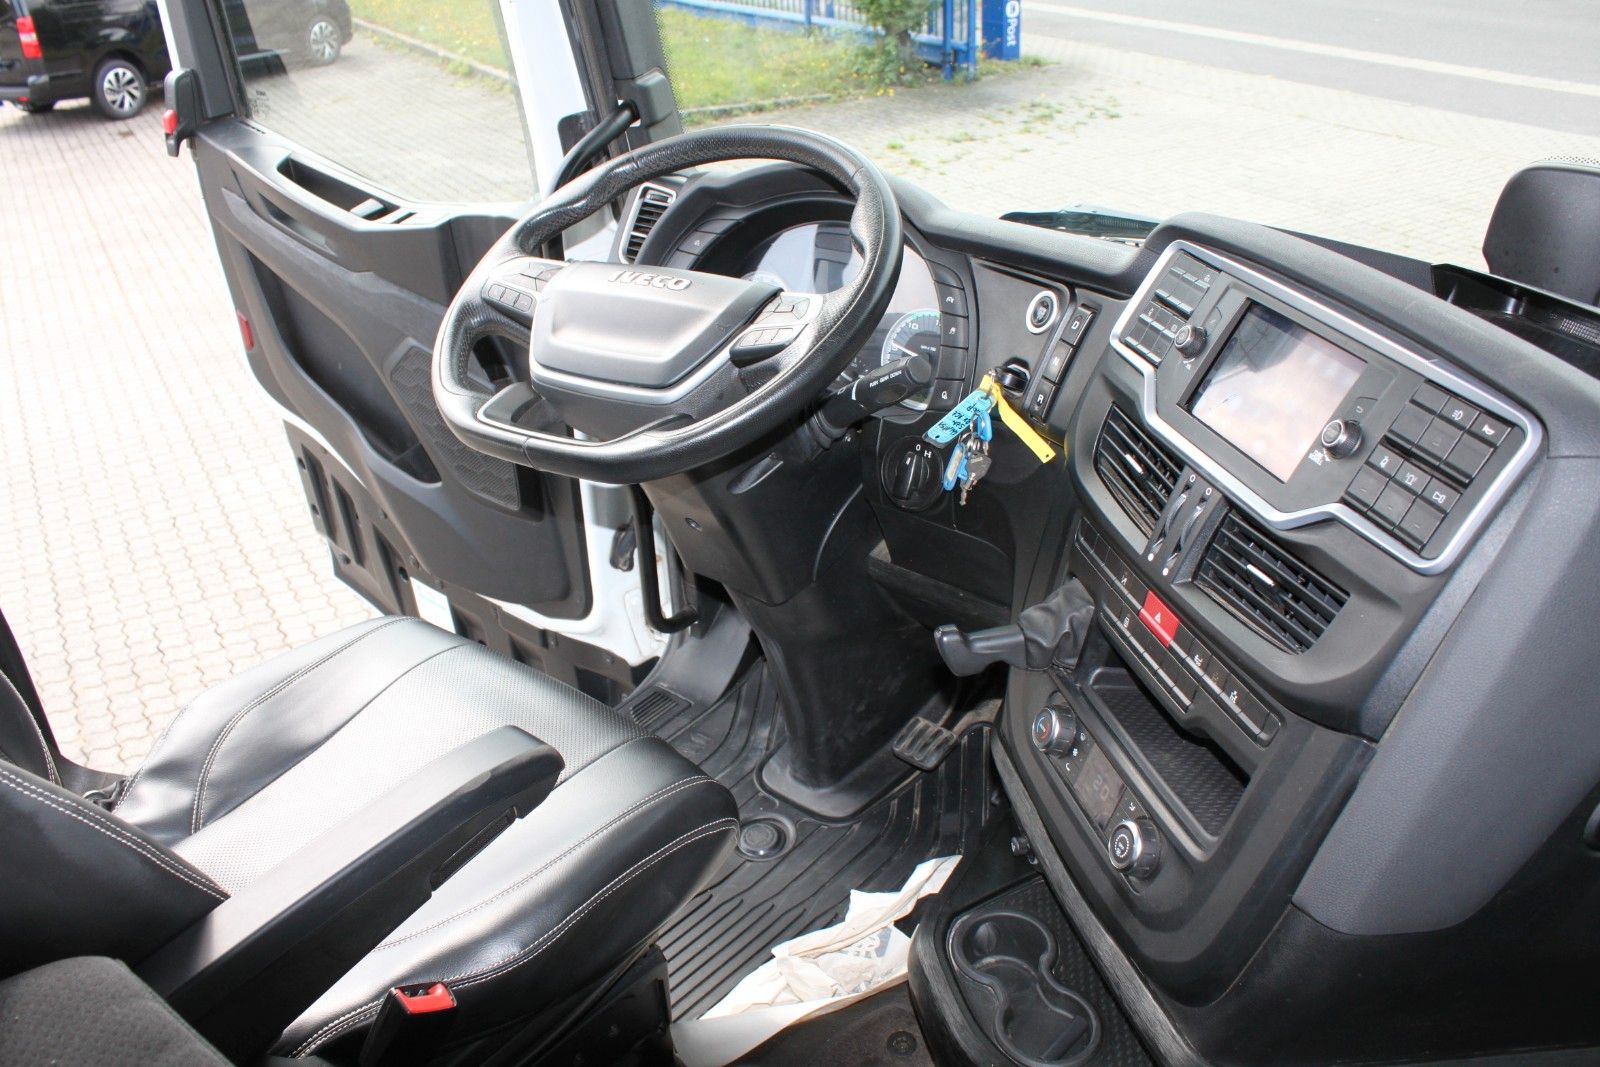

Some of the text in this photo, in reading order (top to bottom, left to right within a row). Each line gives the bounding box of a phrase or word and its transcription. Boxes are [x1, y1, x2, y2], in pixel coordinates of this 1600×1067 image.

[608, 270, 693, 291] IVECO
[1070, 320, 1080, 330] D
[1036, 394, 1044, 404] R
